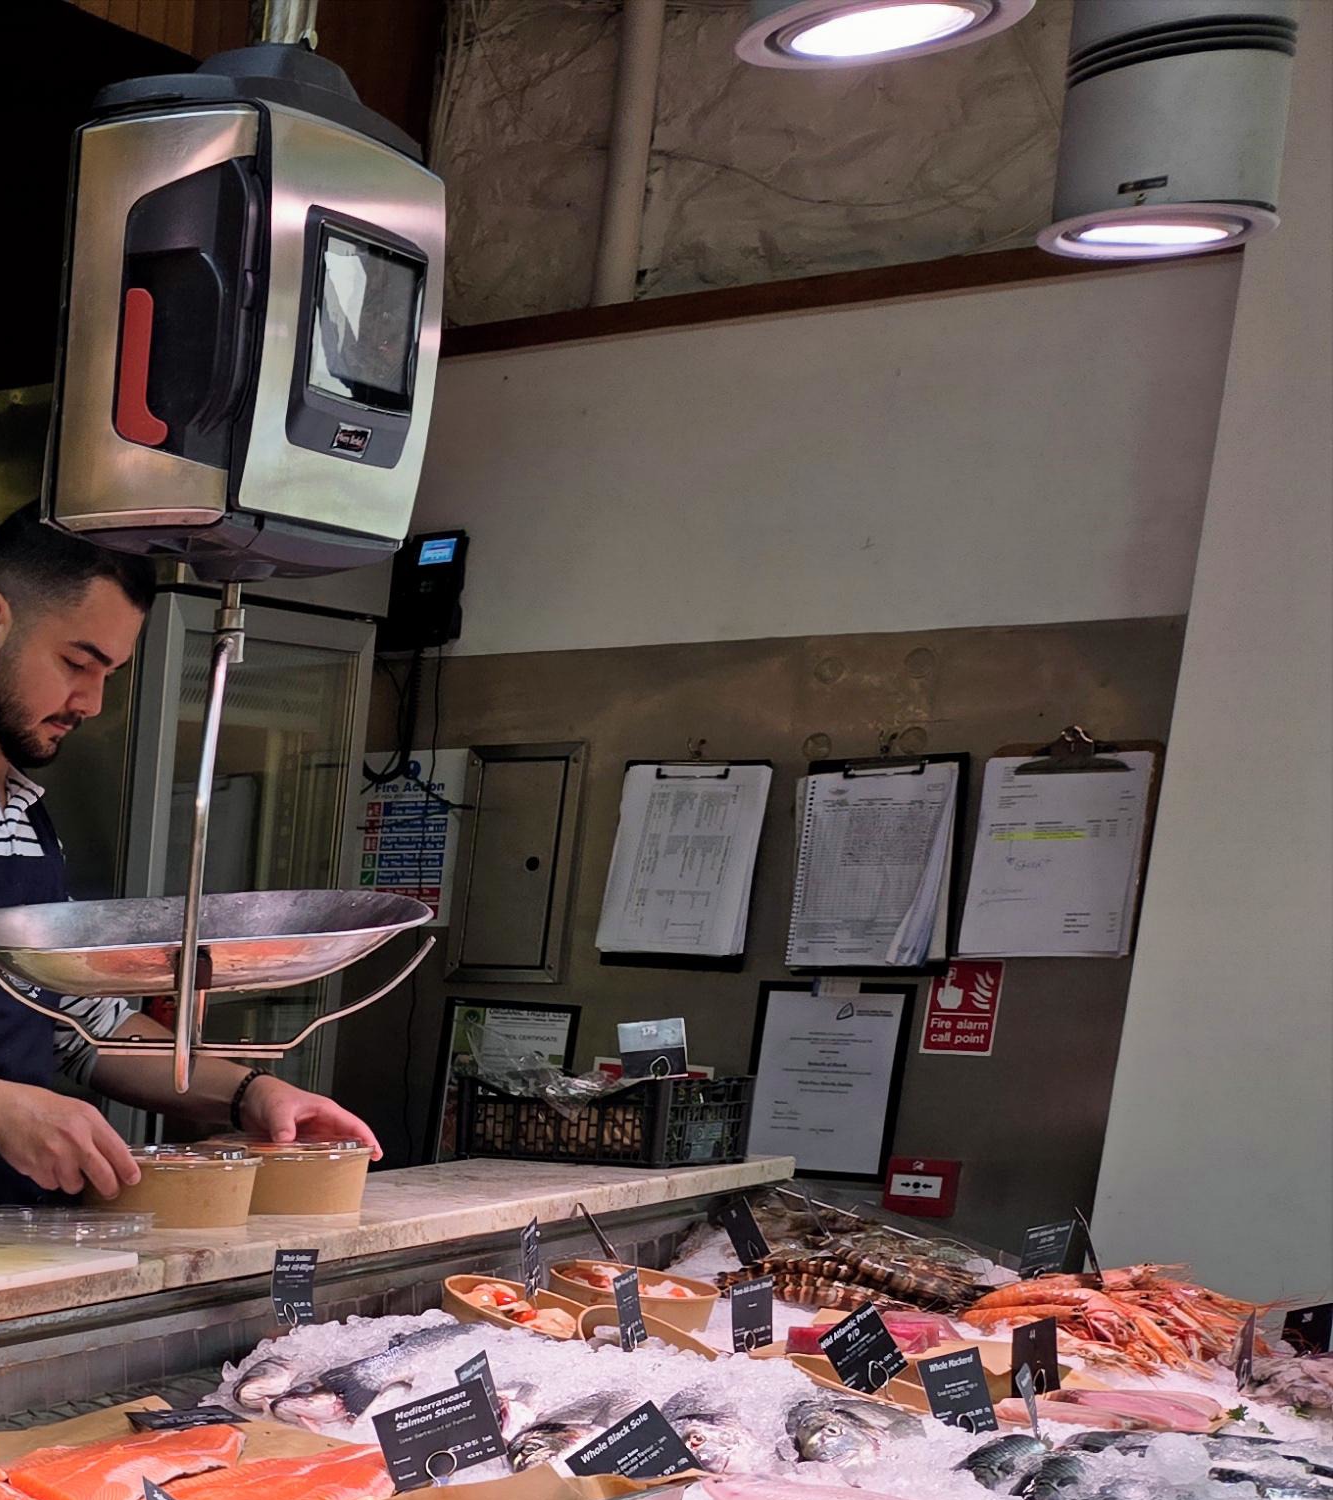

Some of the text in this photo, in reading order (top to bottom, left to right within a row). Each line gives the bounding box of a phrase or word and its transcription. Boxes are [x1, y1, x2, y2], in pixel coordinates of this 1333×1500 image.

[375, 783, 399, 793] Fire
[930, 1018, 989, 1030] Fire alarm
[931, 1032, 984, 1044] call point
[395, 1390, 467, 1421] Mediterranean
[396, 1400, 473, 1432] Salmon Skewer
[580, 1413, 649, 1464] Whole Black Sole
